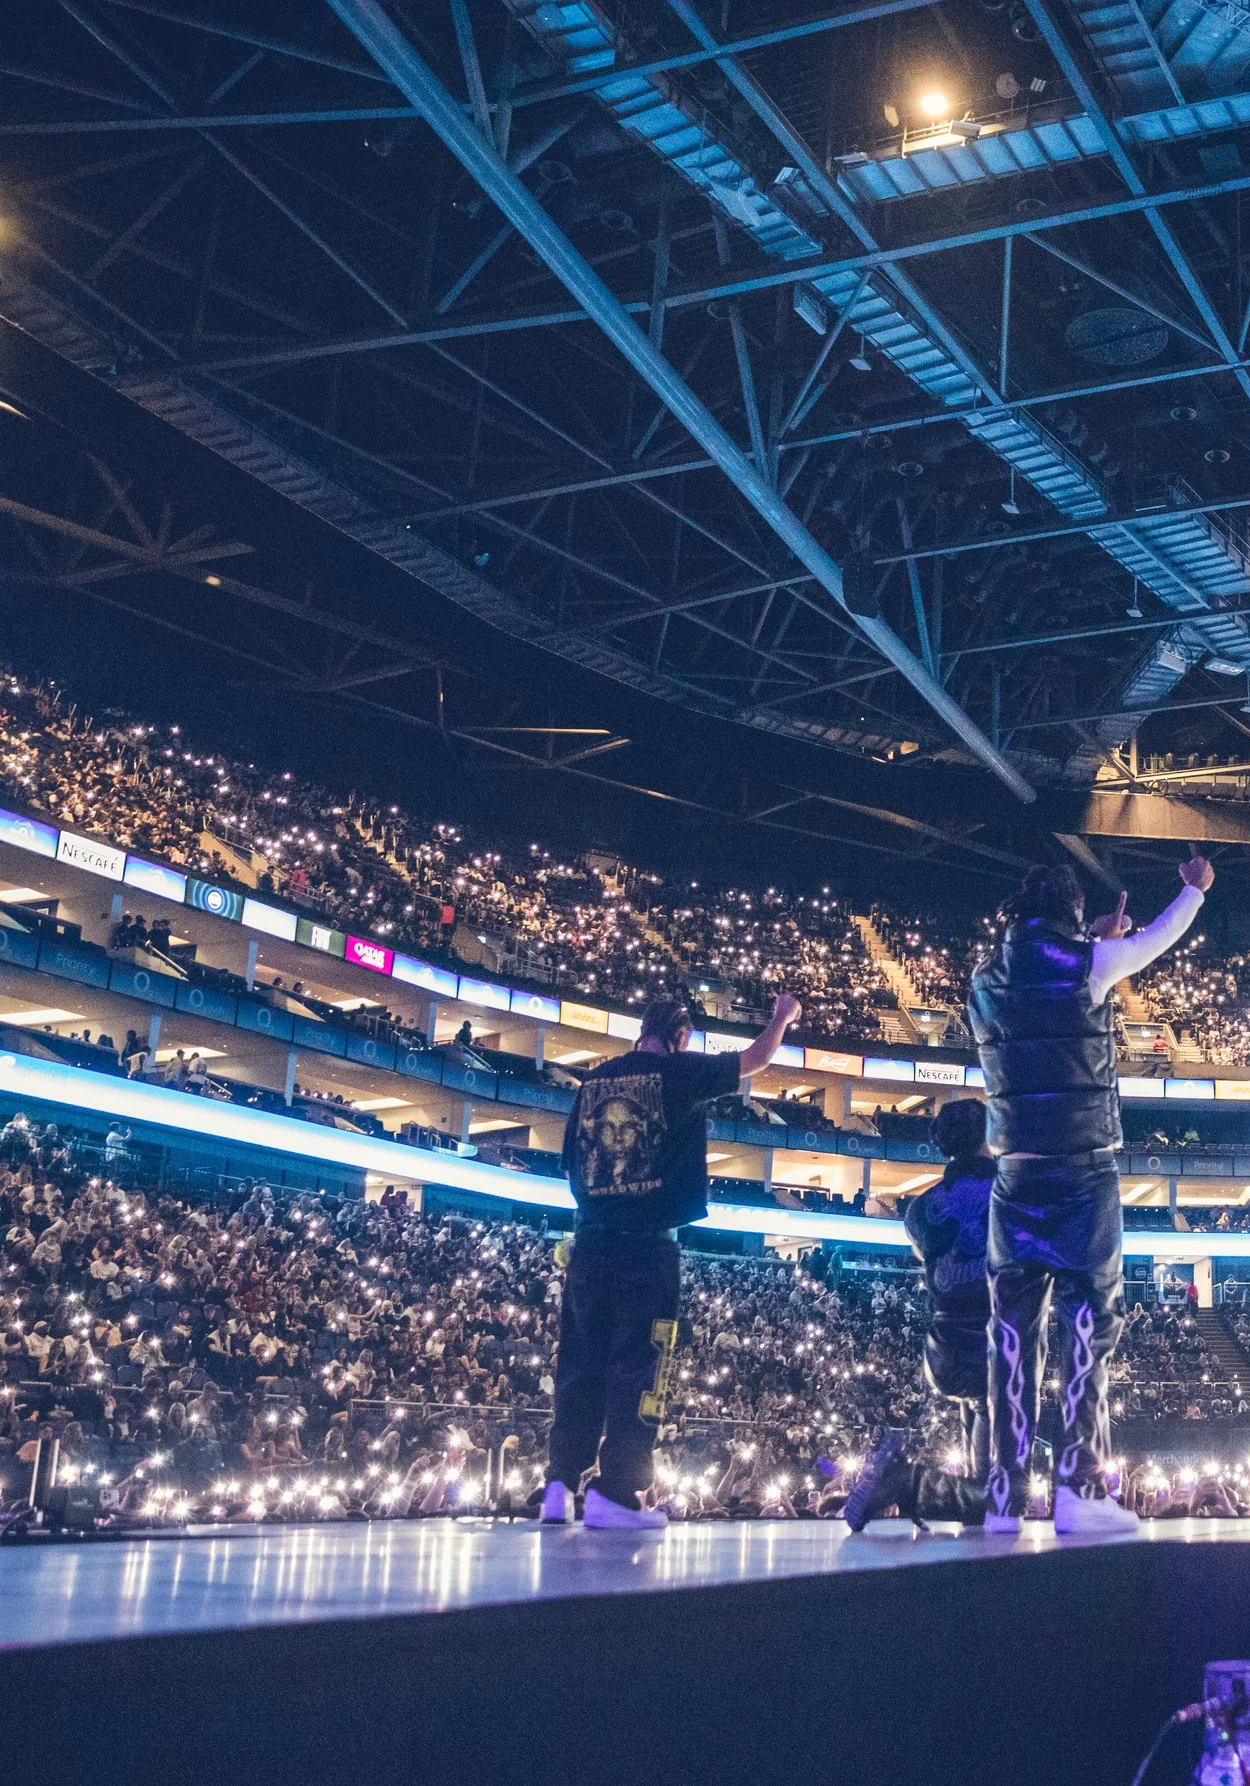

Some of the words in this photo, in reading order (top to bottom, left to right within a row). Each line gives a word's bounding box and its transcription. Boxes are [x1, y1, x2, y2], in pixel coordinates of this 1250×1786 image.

[62, 841, 118, 874] NESCAFÉ
[354, 942, 385, 962] QATAR
[918, 1069, 960, 1082] NESCAFÉ
[1146, 1453, 1206, 1464] Merchandis
